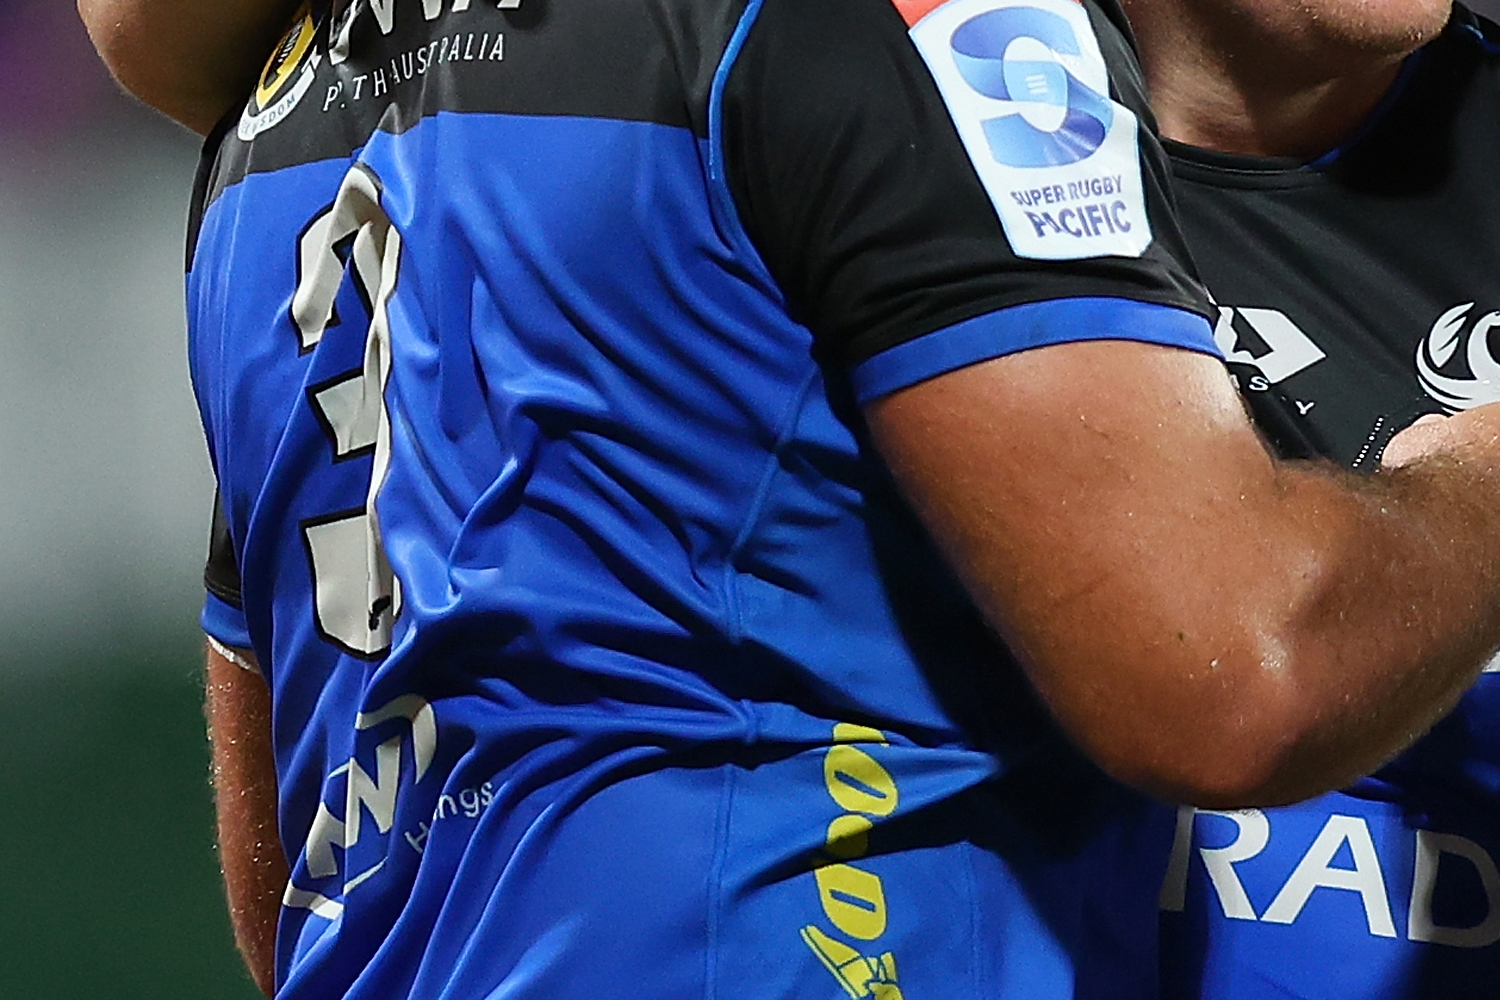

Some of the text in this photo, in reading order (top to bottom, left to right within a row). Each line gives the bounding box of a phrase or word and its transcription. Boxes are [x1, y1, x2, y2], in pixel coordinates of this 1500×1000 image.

[1010, 174, 1124, 208] SUPER RUGBY
[1024, 199, 1132, 239] PACIFIC
[290, 160, 404, 663] 3
